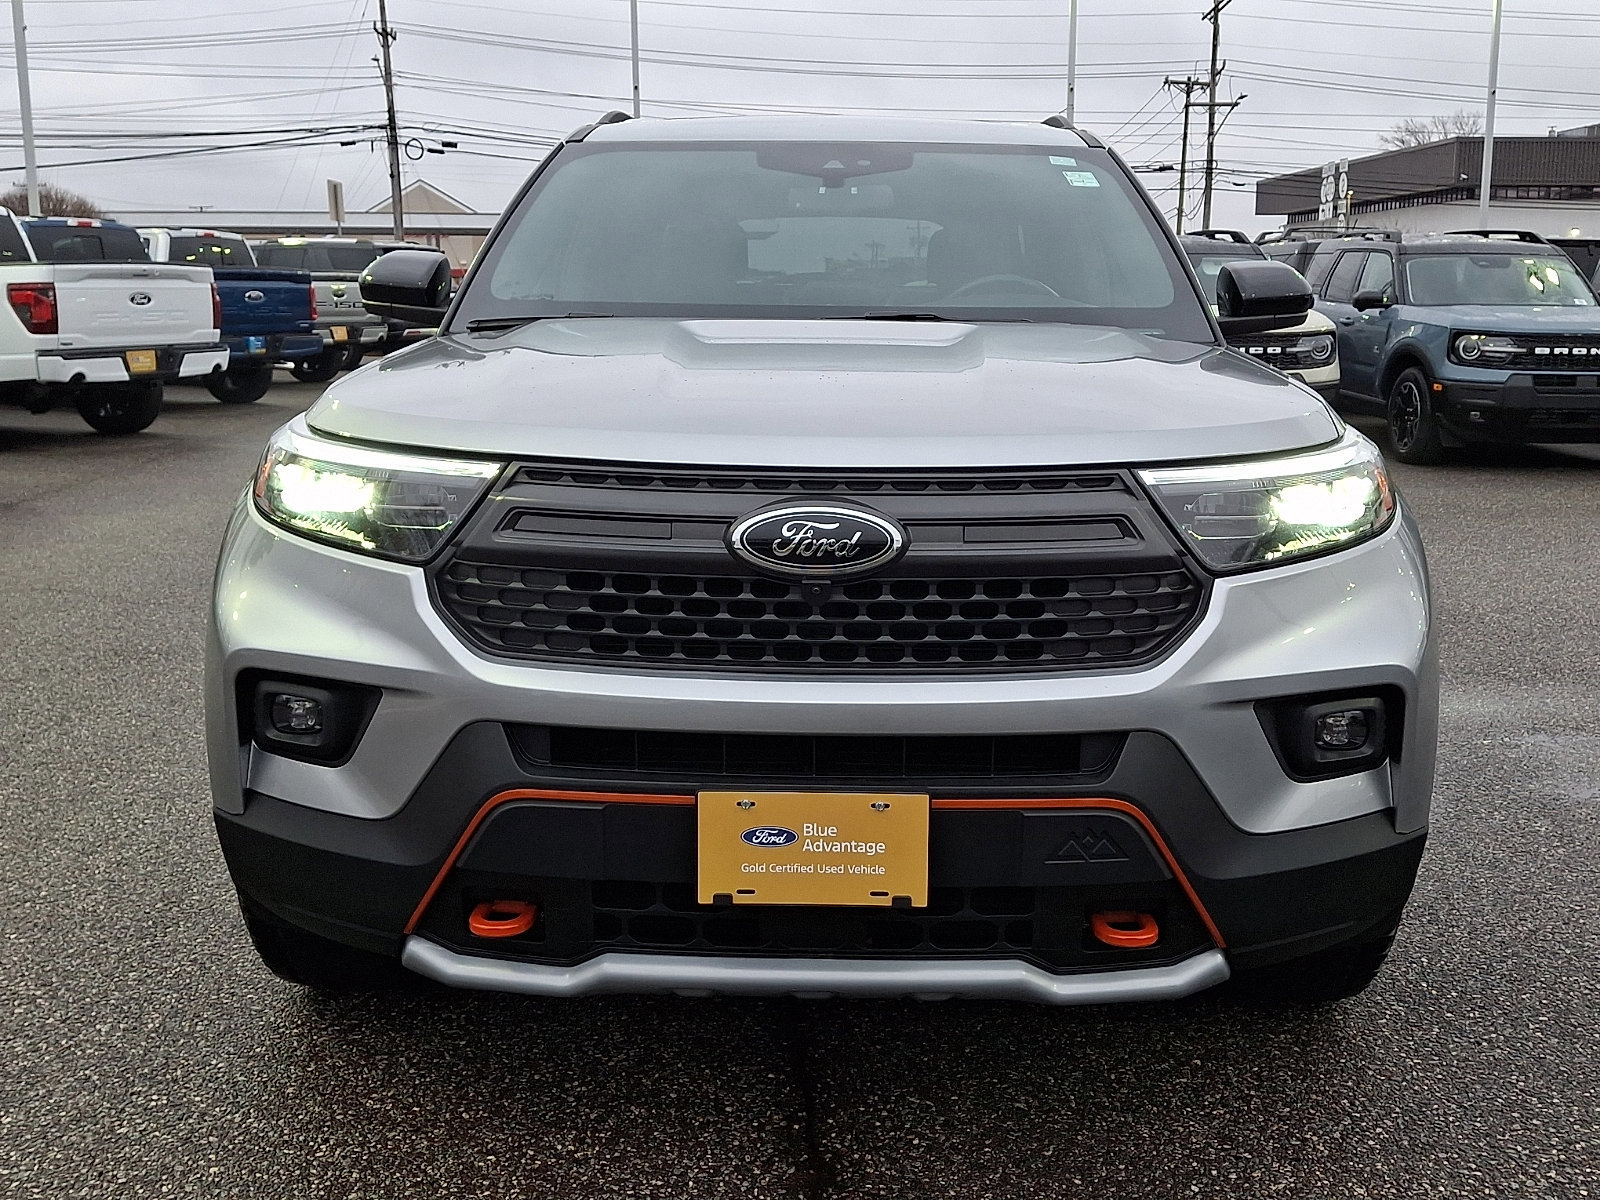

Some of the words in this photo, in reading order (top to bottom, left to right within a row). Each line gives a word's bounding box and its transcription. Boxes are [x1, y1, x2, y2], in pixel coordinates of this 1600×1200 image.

[772, 520, 862, 558] Ford
[752, 829, 787, 844] Ford
[803, 823, 838, 837] Blue
[802, 839, 886, 856] Advantage
[741, 863, 766, 873] Gold
[769, 863, 814, 874] Certified
[817, 864, 844, 874] Used
[848, 864, 886, 875] Vehicle
